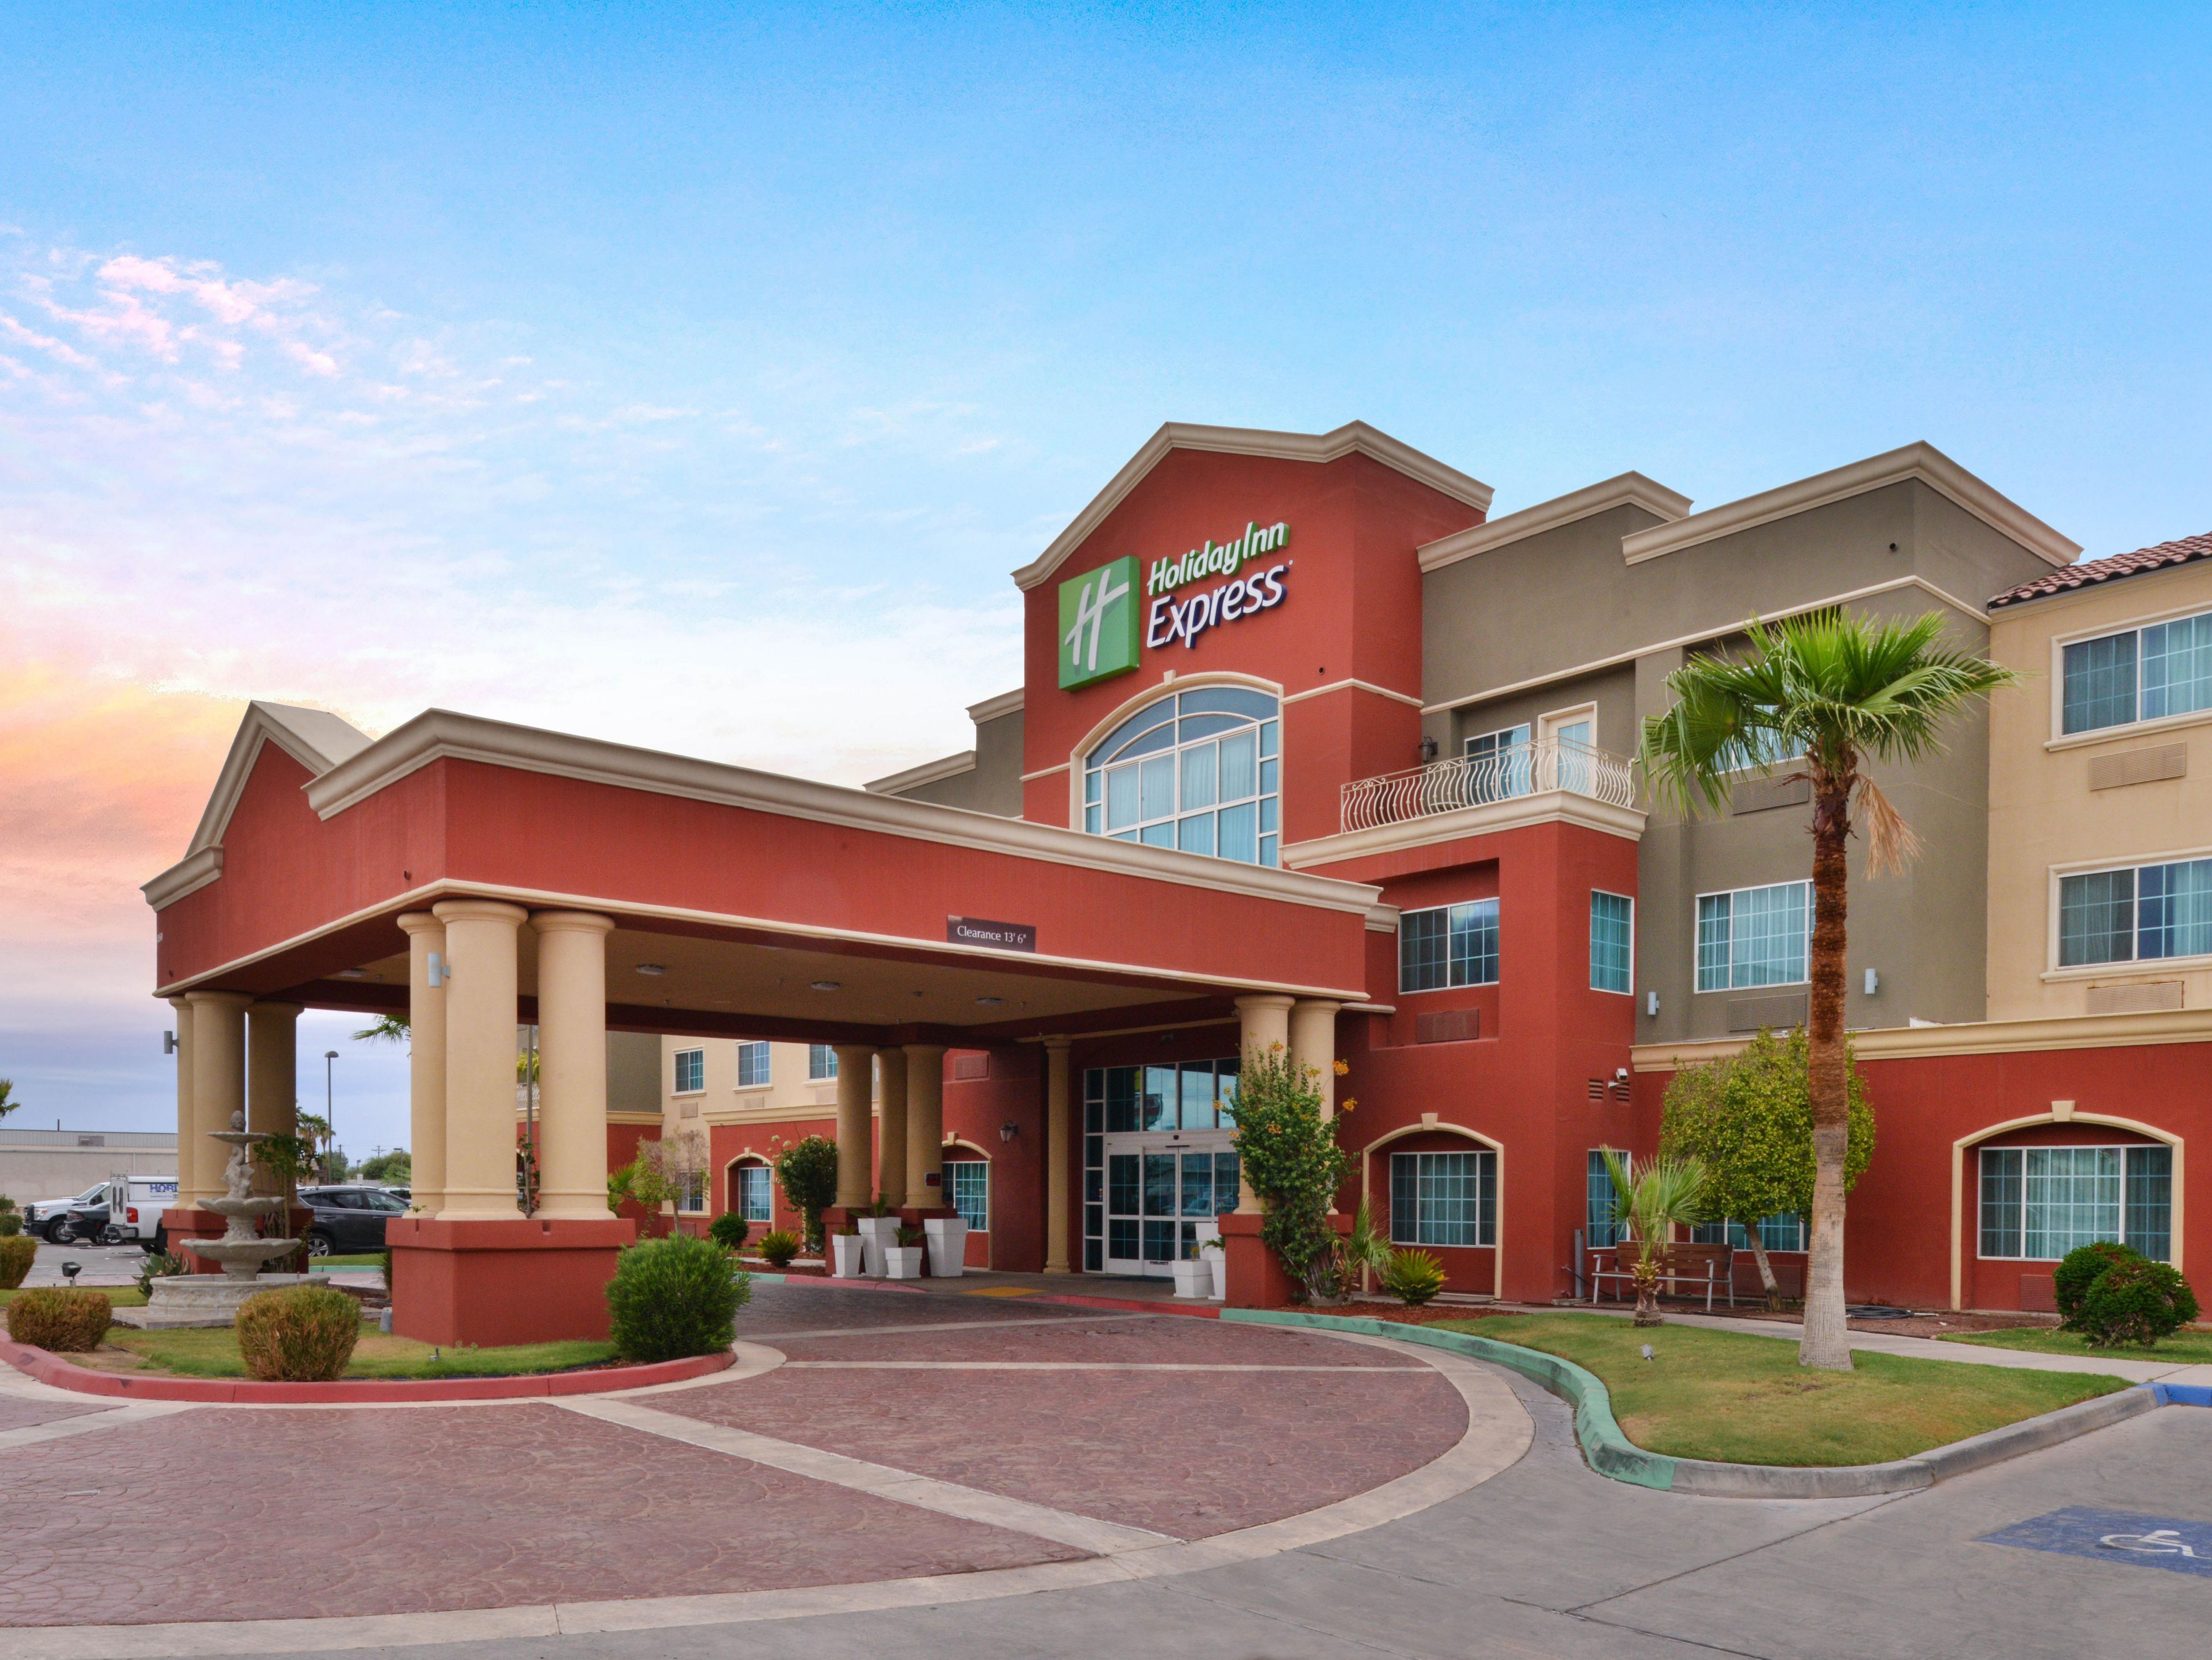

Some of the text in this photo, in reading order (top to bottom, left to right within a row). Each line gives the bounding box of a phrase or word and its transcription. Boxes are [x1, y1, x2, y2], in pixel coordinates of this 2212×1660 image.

[1147, 522, 1289, 596] Holiday Inn
[1065, 569, 1129, 672] H
[1146, 565, 1289, 649] Express
[957, 925, 1001, 940] Clearance
[1004, 932, 1015, 943] 13'
